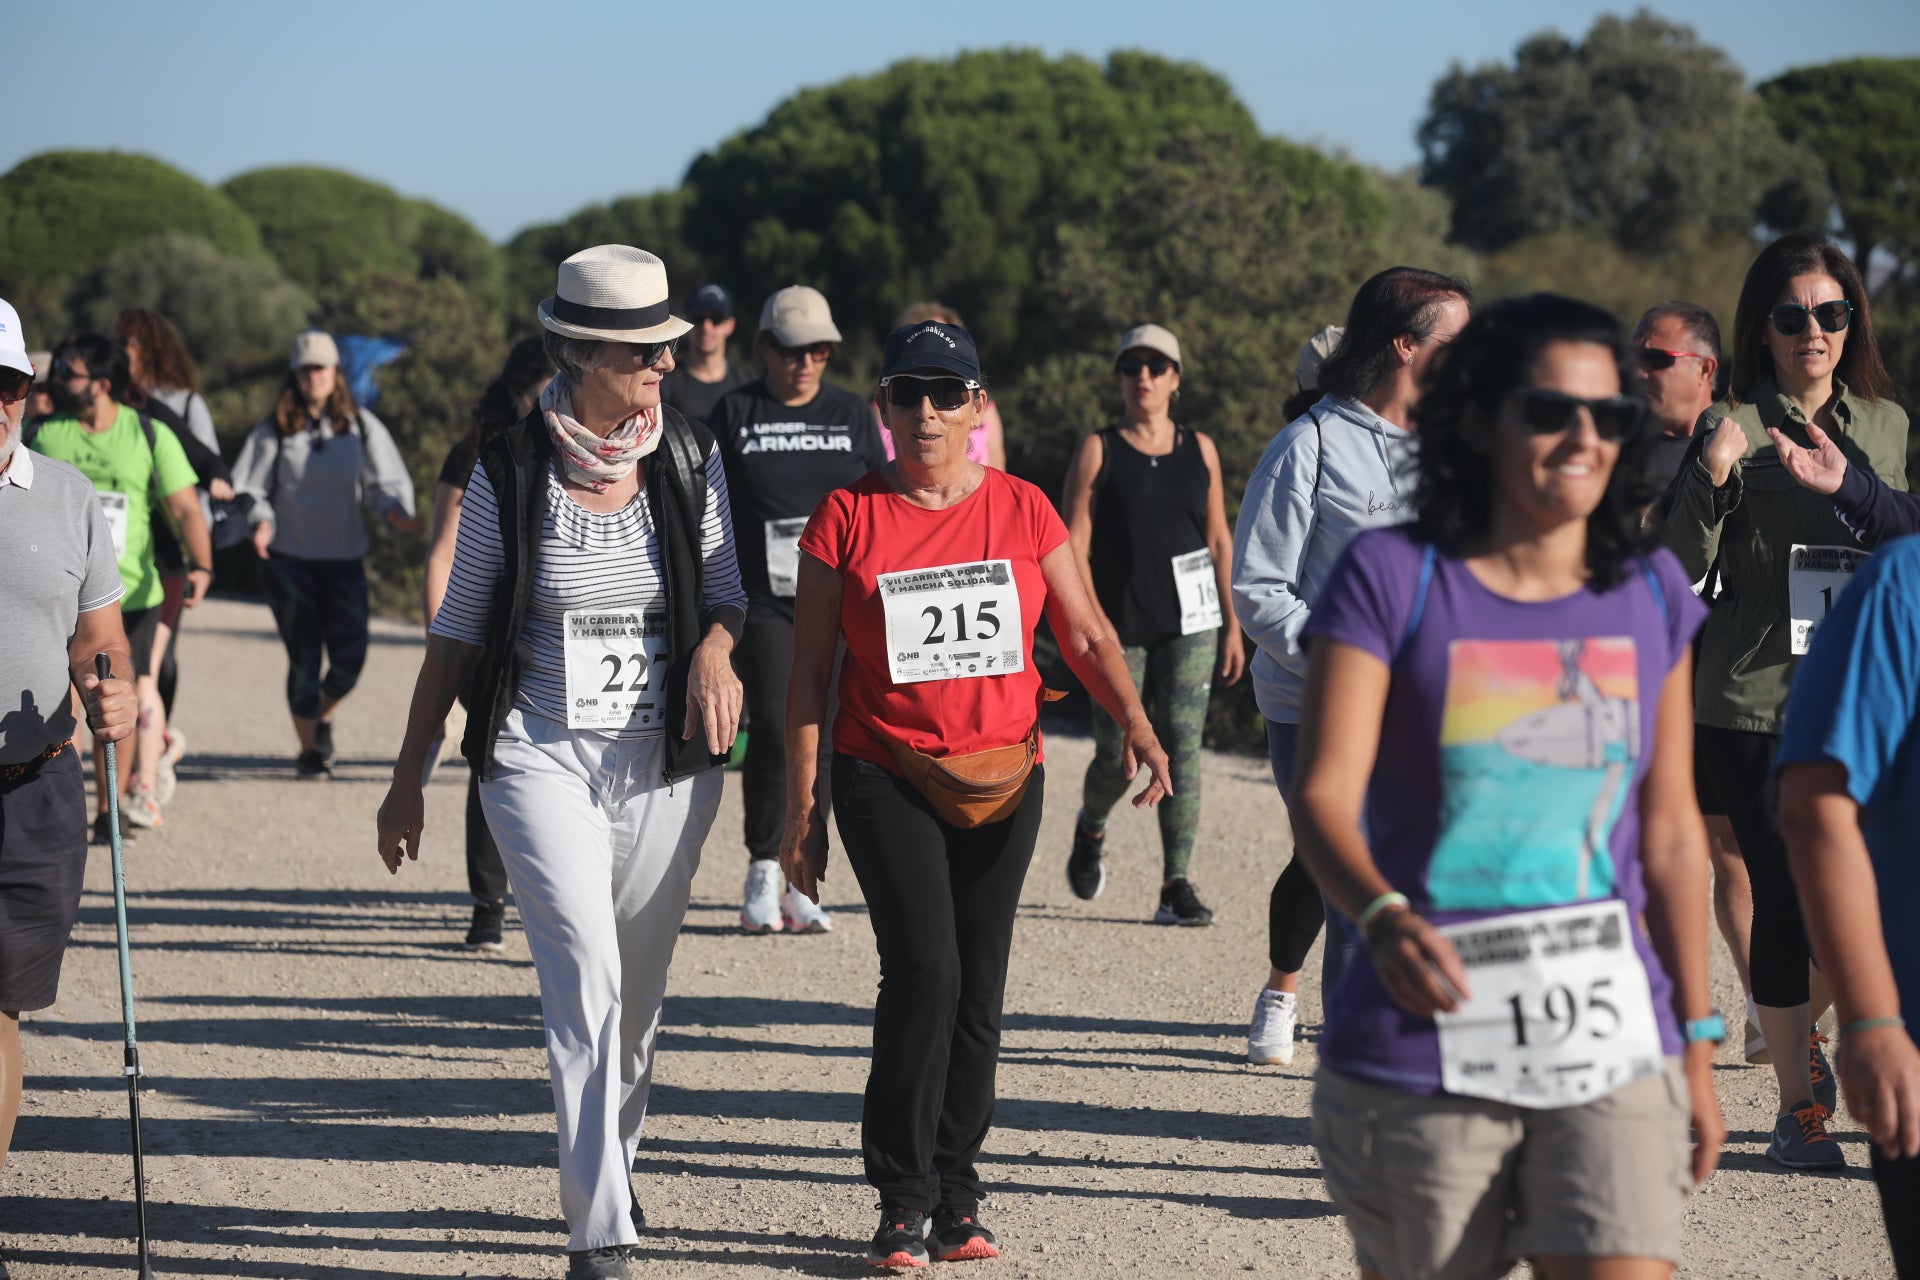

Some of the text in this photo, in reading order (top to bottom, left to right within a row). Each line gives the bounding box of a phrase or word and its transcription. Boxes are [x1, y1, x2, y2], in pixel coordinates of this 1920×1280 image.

[753, 422, 807, 435] UNDER
[742, 434, 852, 455] ARMOUR
[1797, 561, 1804, 569] Y
[885, 578, 902, 587] VII
[904, 570, 955, 584] CARRERA
[899, 581, 945, 593] MARCHA
[589, 616, 640, 626] CARRERA
[921, 600, 1001, 645] 215
[571, 628, 579, 637] Y
[581, 627, 628, 637] MARCHA
[906, 652, 919, 660] NB
[600, 653, 668, 692] 227
[1507, 976, 1621, 1047] 195
